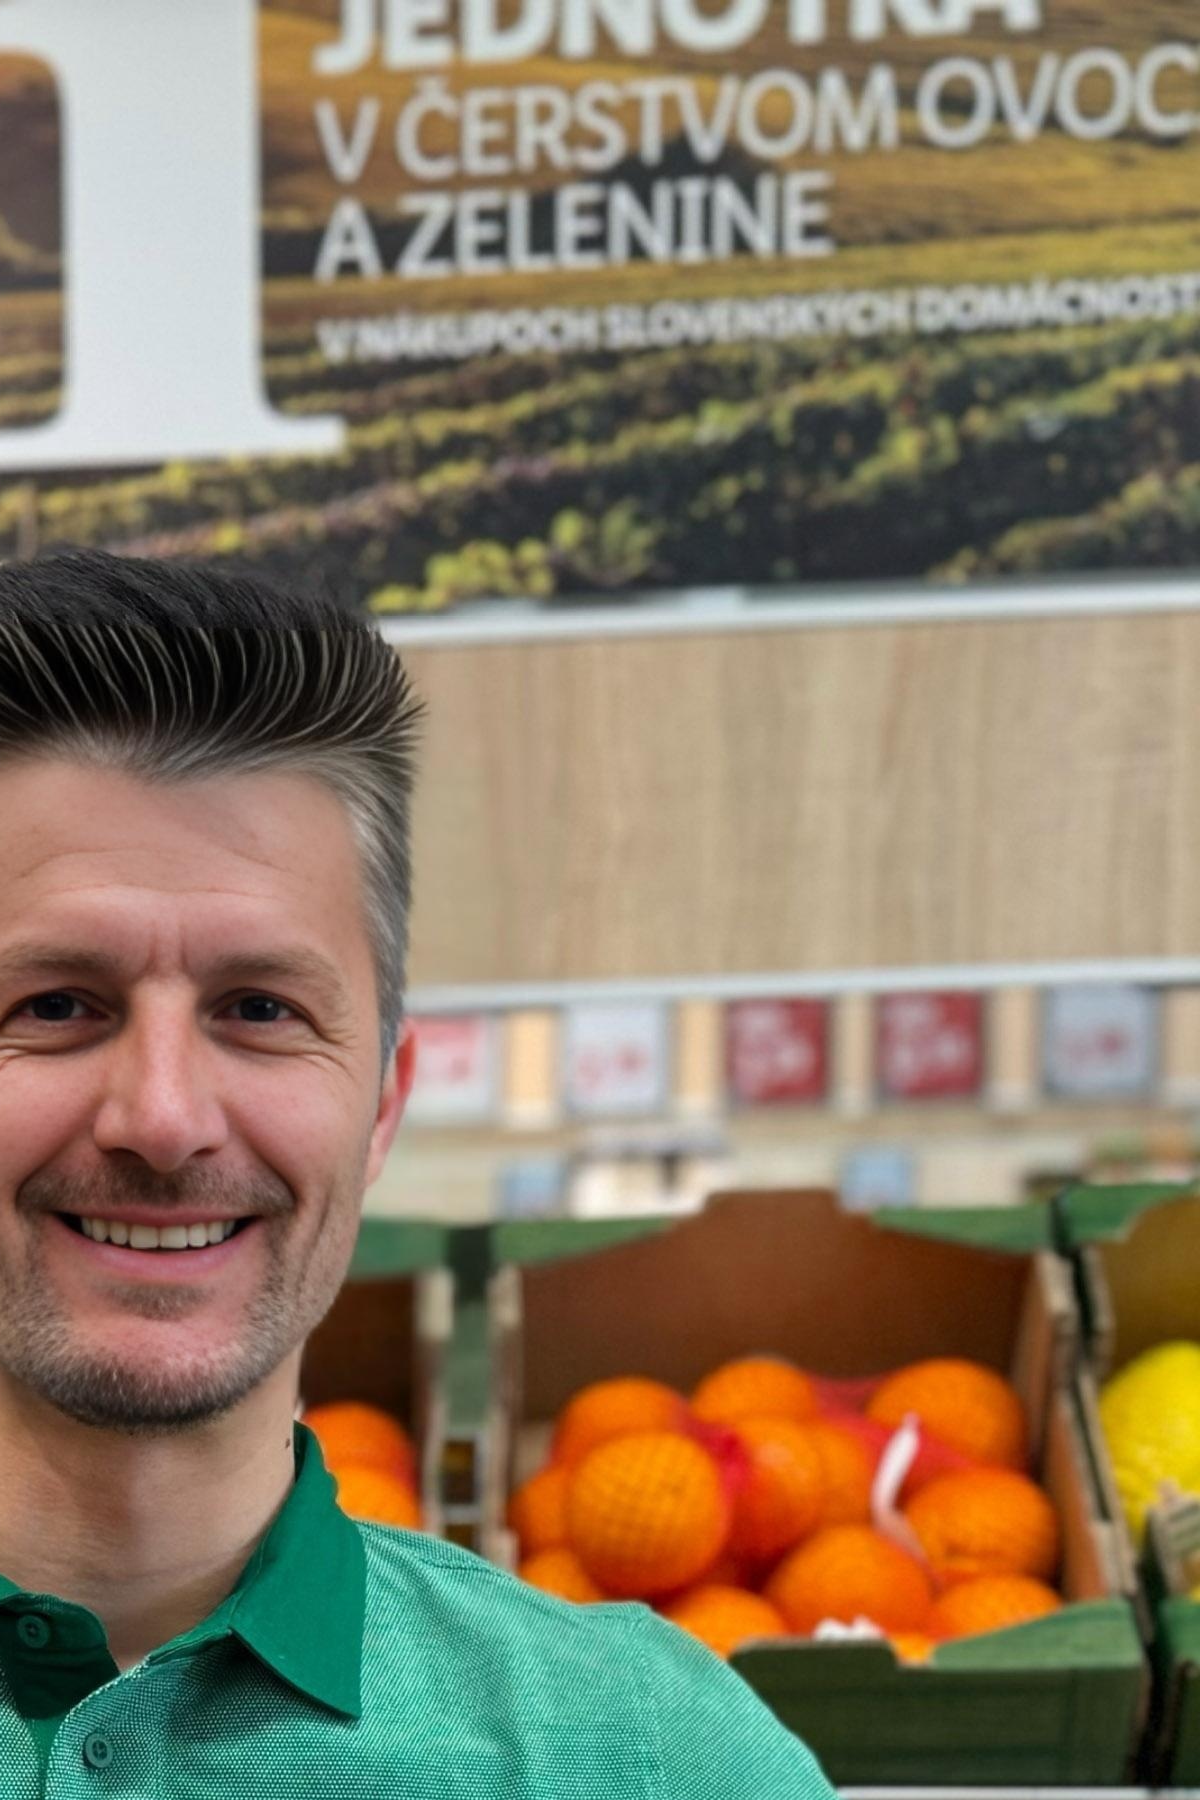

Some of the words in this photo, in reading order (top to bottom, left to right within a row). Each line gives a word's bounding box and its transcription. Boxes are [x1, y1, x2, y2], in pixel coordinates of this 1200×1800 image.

[312, 0, 1043, 75] JEDNO
[314, 97, 380, 184] V
[395, 63, 899, 182] ČERSTVOM
[313, 198, 384, 282] A
[397, 171, 836, 279] ZELENINE
